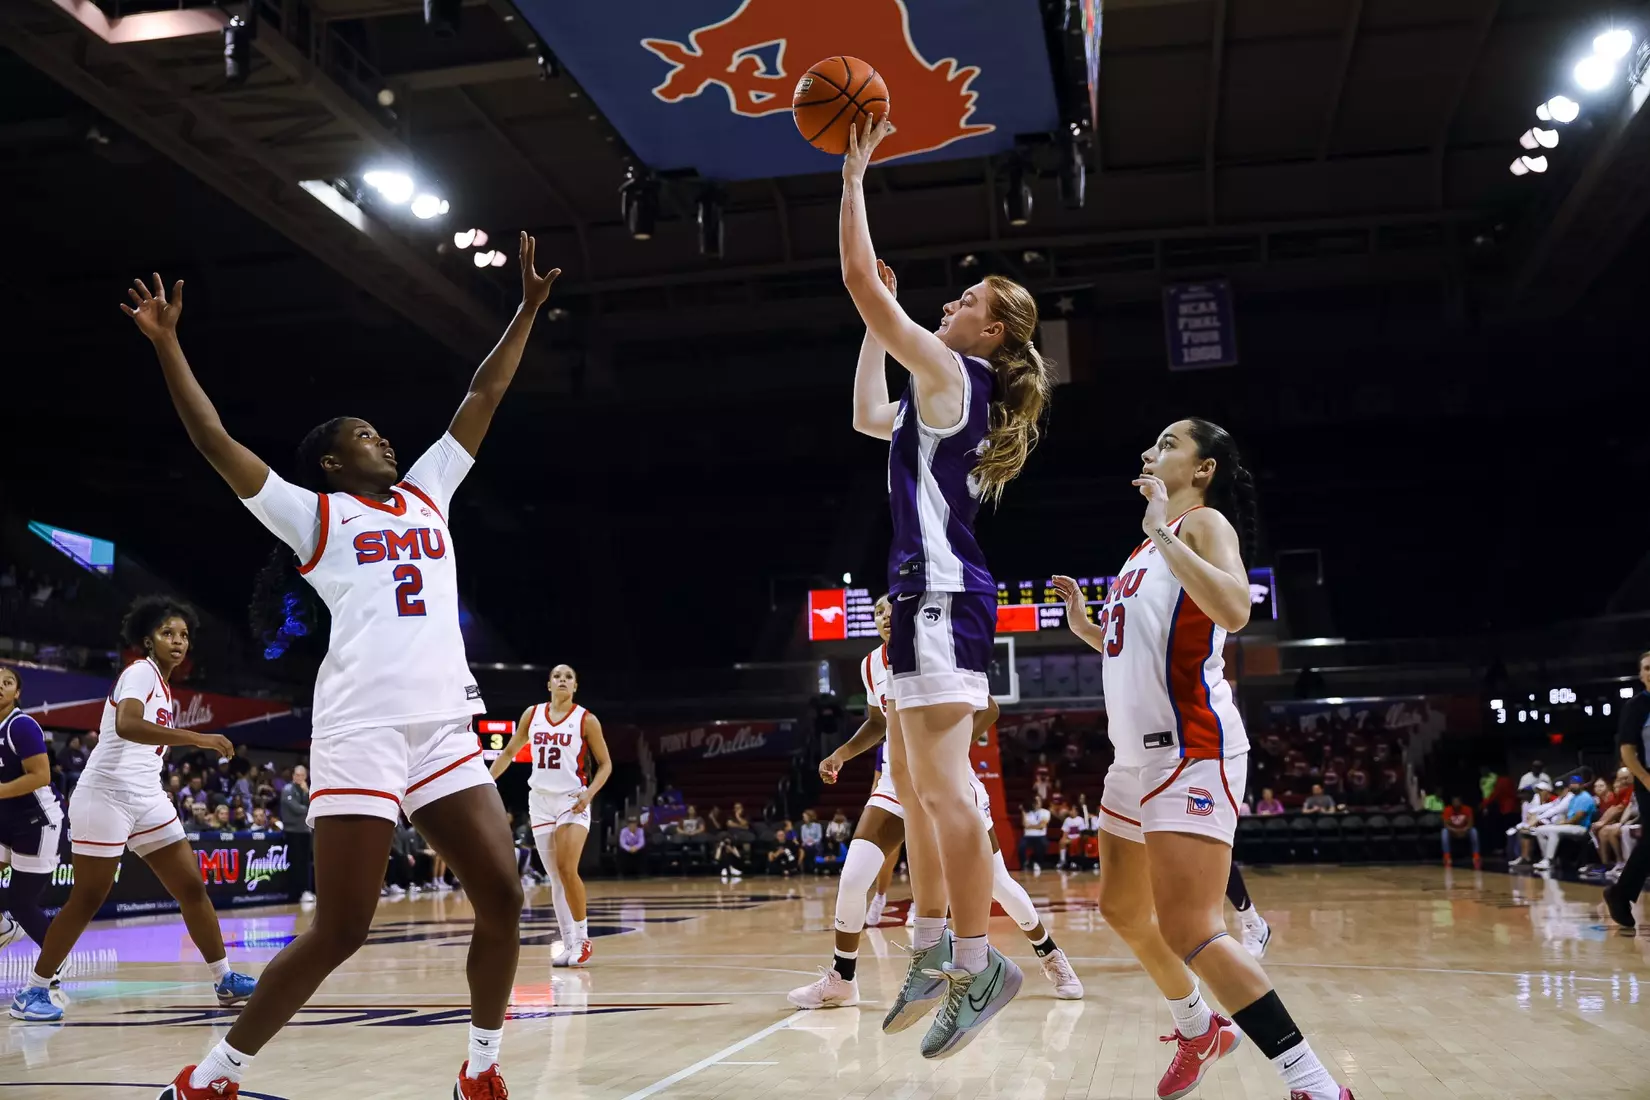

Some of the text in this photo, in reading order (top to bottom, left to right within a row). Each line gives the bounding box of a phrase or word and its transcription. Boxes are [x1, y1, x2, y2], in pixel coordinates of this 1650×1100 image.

[353, 528, 446, 565] SMU
[393, 563, 427, 617] 2
[491, 734, 503, 749] 3
[533, 732, 572, 747] SMU
[702, 726, 766, 758] Dallas
[537, 746, 561, 770] 12
[193, 844, 291, 891] MU Ignited
